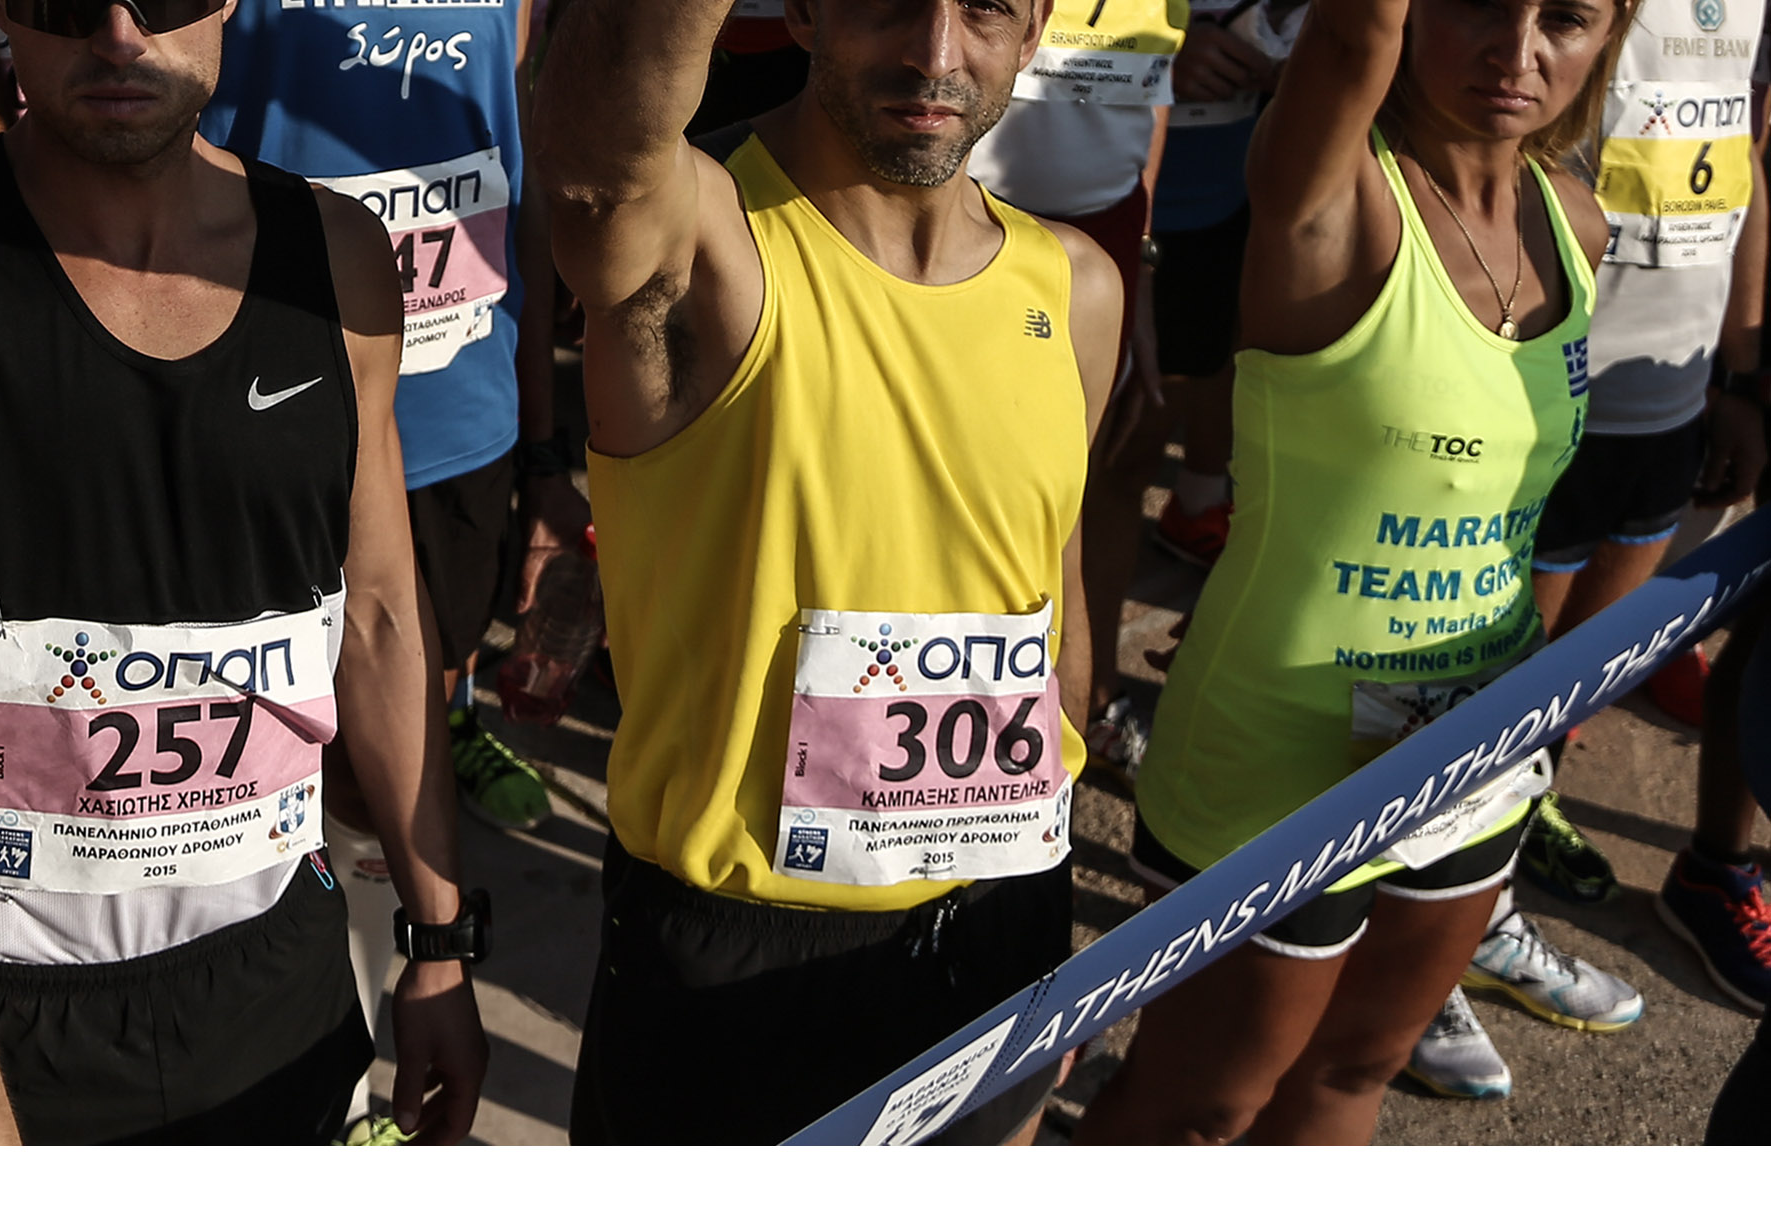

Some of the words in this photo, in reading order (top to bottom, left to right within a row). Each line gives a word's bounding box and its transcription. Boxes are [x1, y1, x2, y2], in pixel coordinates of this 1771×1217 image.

[338, 22, 473, 101] Σύρος
[1689, 141, 1714, 196] 6
[1430, 434, 1484, 458] TOC
[1332, 559, 1462, 602] TEAM
[1388, 616, 1419, 640] by
[1334, 645, 1451, 673] NOTHING
[1455, 645, 1475, 667] IS
[85, 694, 254, 792] 257
[878, 696, 1044, 782] 306
[77, 792, 172, 817] ΧΑΣΙΩΤΗΣ
[176, 780, 259, 811] ΧΡΗΣΤΟΣ
[861, 787, 960, 808] ΚΑΜΠΑΞΗΣ
[963, 779, 1050, 804] ΠΑΝΤΕΛΗΣ
[52, 822, 158, 842] ΠΑΝΕΛΛΗΝΙΟ
[160, 808, 263, 838] ΠΡΩΤΑΘΛΗΜΑ
[848, 817, 944, 833] ΠΑΝΕΛΛΗΝΙΟ
[945, 810, 1040, 829] ΠΡΩΤΑΘΛΗΜΑ
[71, 844, 179, 861] ΜΑΡΑΘΩΝΙΟΥ
[181, 832, 245, 856] ΔΡΟΜΟΥ
[865, 832, 955, 854] ΜΑΡΑΘΩΝΙΟΥ
[959, 830, 1021, 845] ΔΡΟΜΟΥ
[1005, 881, 1271, 1075] ATHENS
[1261, 680, 1582, 918] MARATHON
[1586, 613, 1686, 705] THE
[143, 864, 178, 878] 2015
[922, 852, 955, 865] 2015
